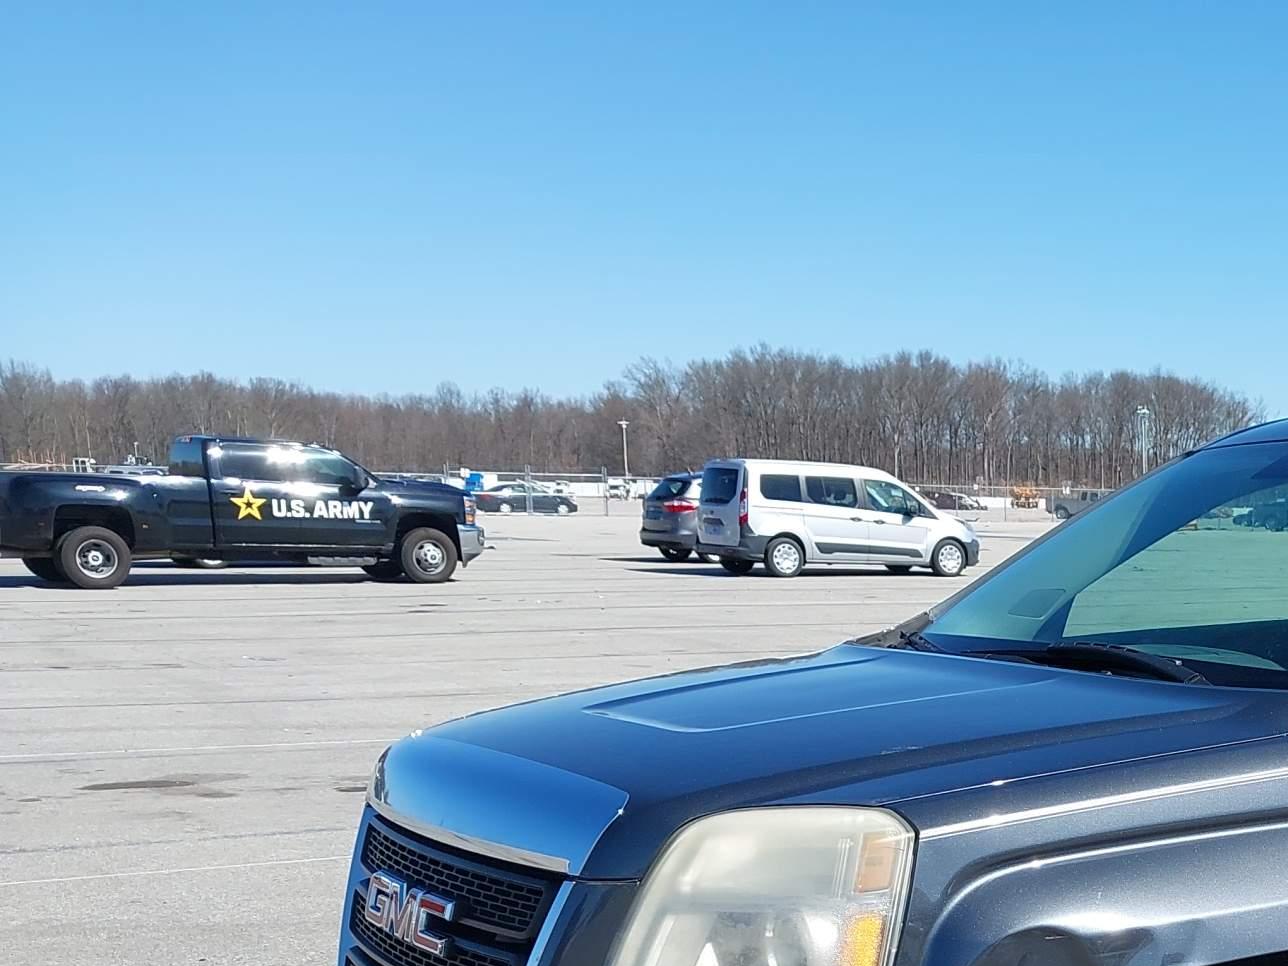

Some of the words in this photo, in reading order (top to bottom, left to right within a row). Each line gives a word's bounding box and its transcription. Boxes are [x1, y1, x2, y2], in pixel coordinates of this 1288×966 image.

[271, 499, 311, 518] U.S.
[313, 500, 374, 519] ARMY
[365, 869, 455, 957] GMC
